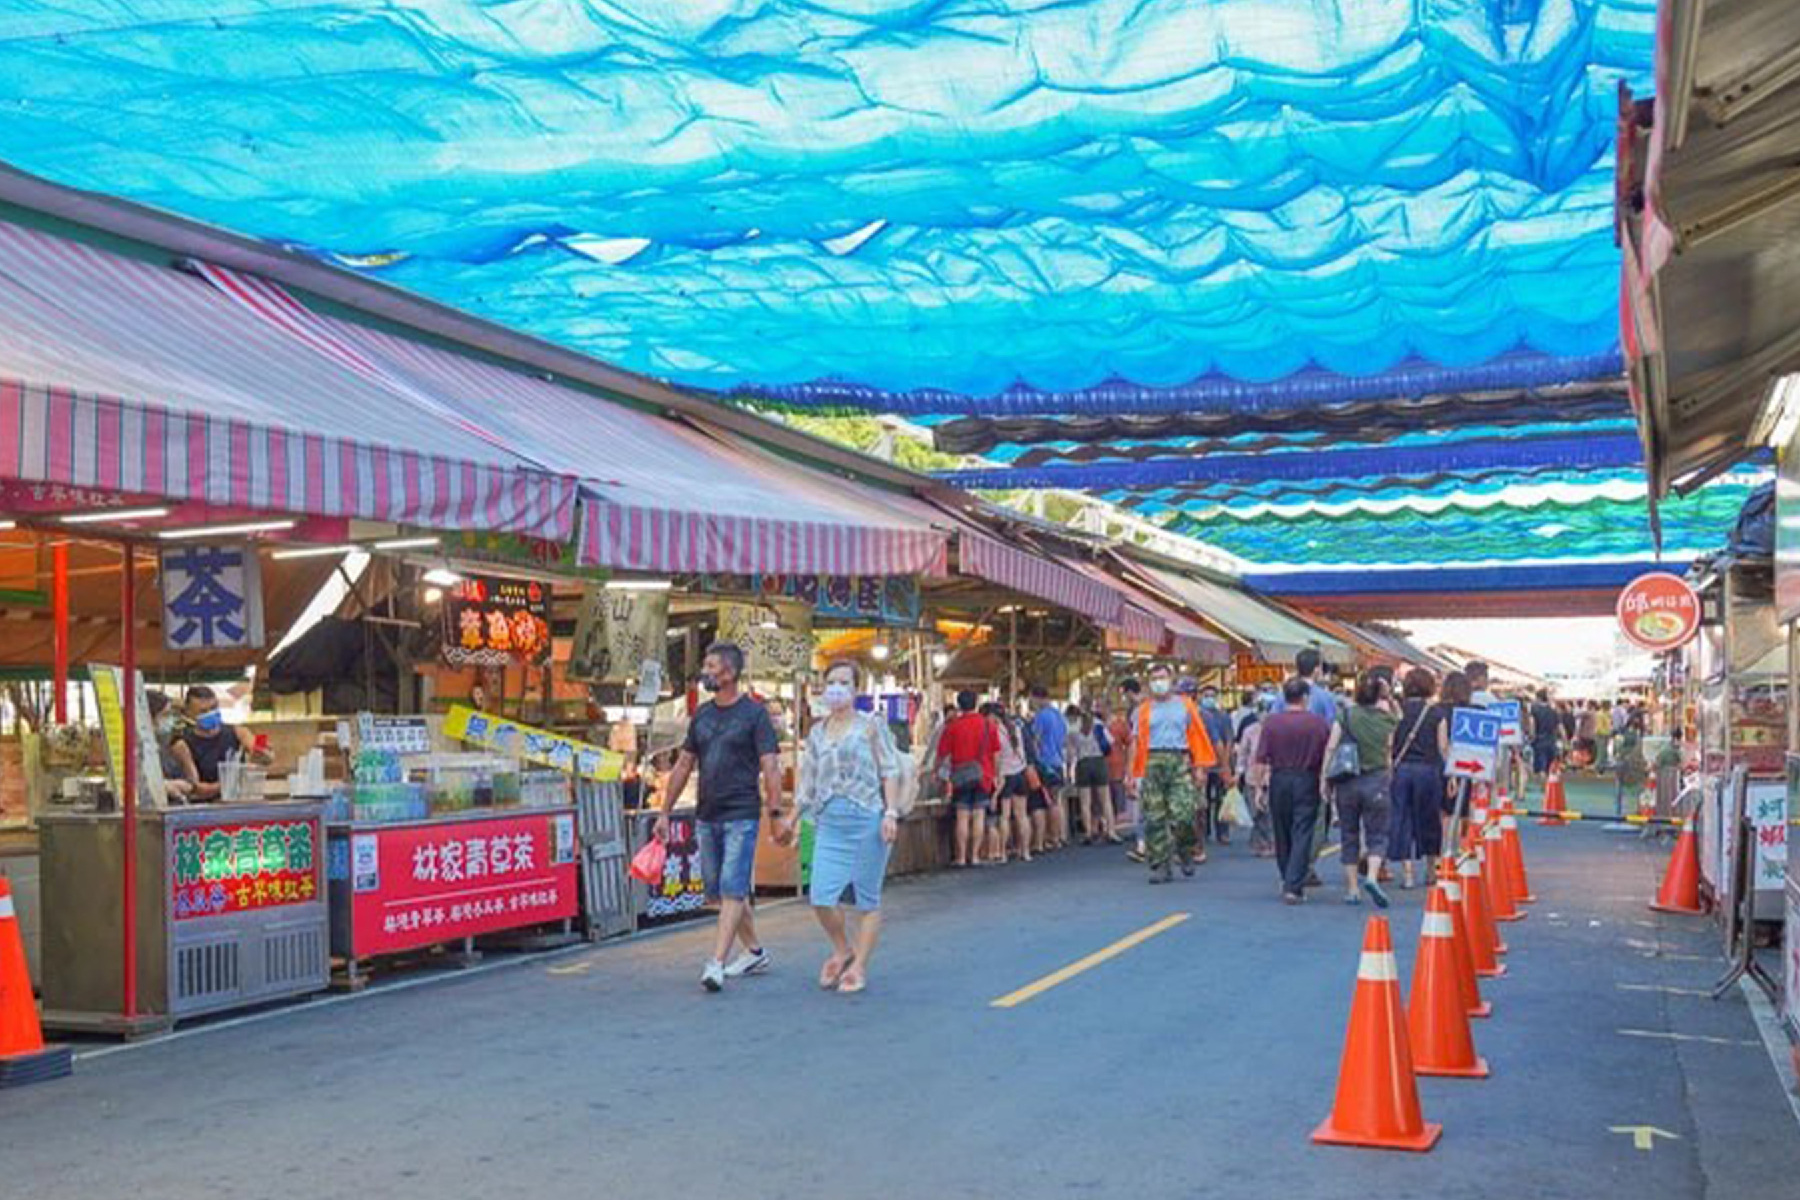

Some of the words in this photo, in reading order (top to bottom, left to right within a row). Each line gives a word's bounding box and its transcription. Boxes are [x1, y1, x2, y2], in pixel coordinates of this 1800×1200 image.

[164, 546, 245, 647] 茶
[1456, 716, 1498, 740] 入口
[175, 823, 312, 885] 林家青草茶
[411, 831, 535, 882] 林家青草茶
